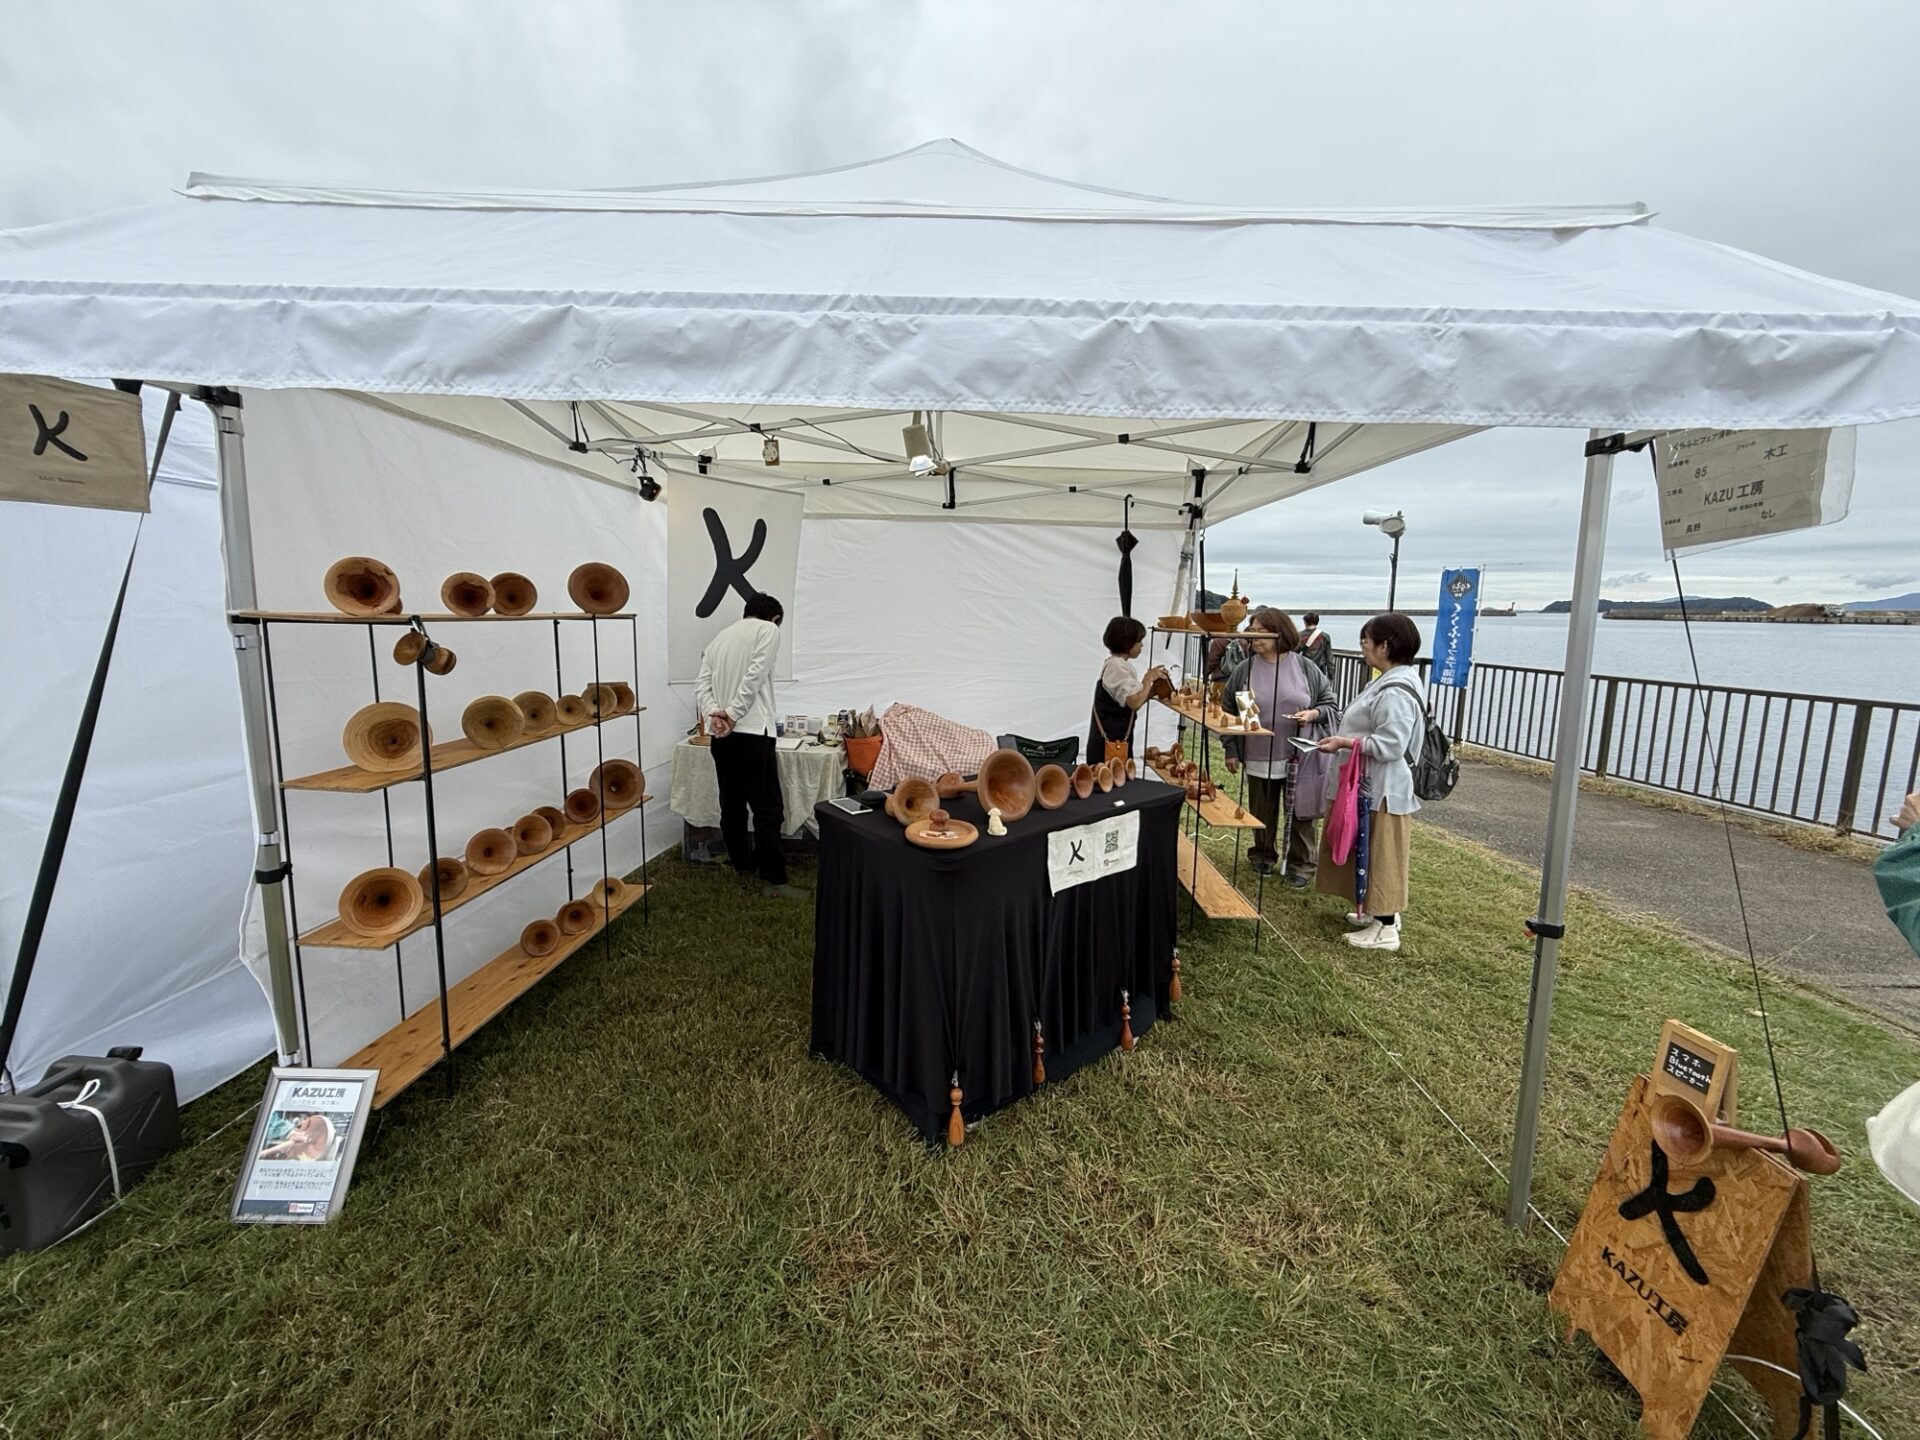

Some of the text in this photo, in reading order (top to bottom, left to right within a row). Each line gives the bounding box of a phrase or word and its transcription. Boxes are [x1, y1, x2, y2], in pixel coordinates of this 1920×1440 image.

[1763, 443, 1789, 460] 木工
[1694, 465, 1708, 479] 85
[1736, 479, 1765, 499] 工房
[1760, 509, 1777, 520] なし
[1670, 1046, 1702, 1069] スマホ
[1666, 1063, 1705, 1088] スピーカー
[1668, 1055, 1712, 1085] Bluetooth
[291, 1087, 347, 1098] KAZU工房
[1601, 1246, 1689, 1337] KAZU工房
